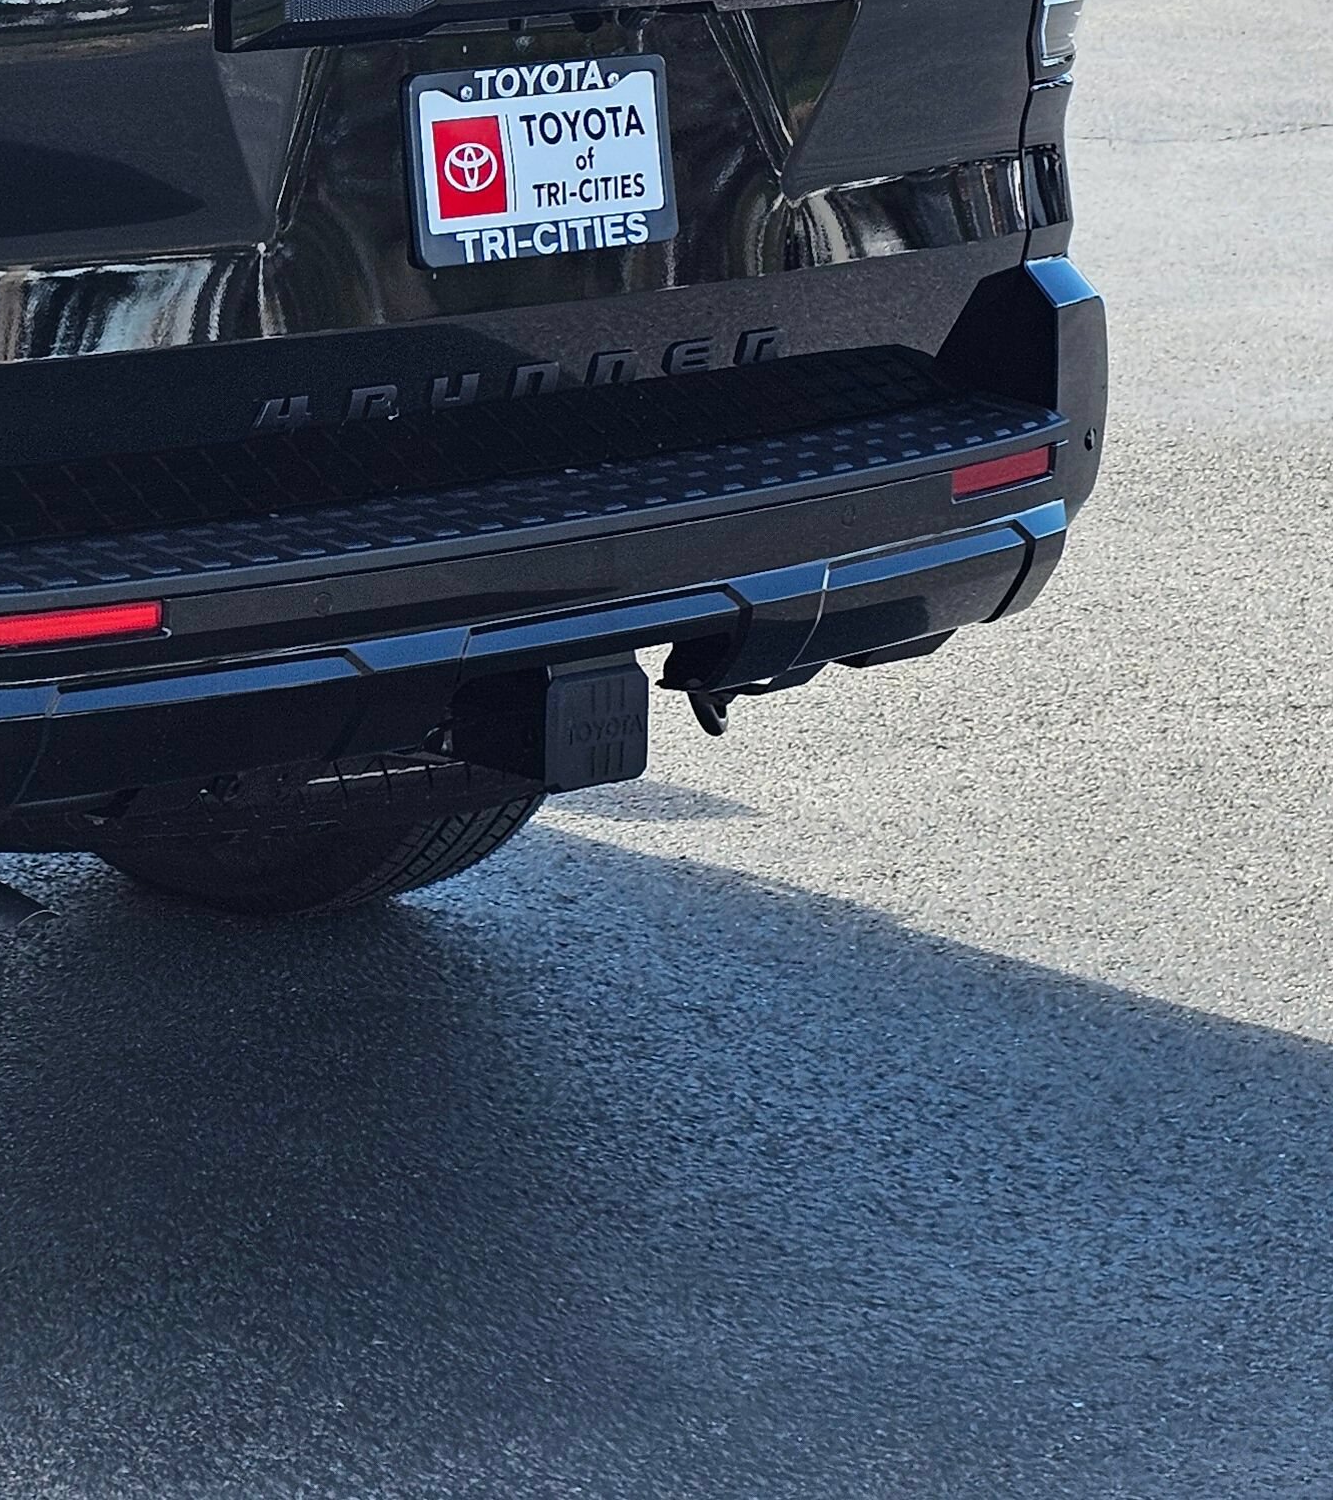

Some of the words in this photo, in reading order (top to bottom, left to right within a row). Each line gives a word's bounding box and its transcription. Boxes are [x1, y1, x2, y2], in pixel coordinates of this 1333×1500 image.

[474, 60, 605, 100] TOYOTA
[519, 104, 645, 146] TOYOTA
[575, 146, 595, 170] of
[532, 173, 646, 207] TRI-CITIES
[456, 212, 649, 263] TRI-CITIES
[566, 712, 643, 746] TOYOTA
